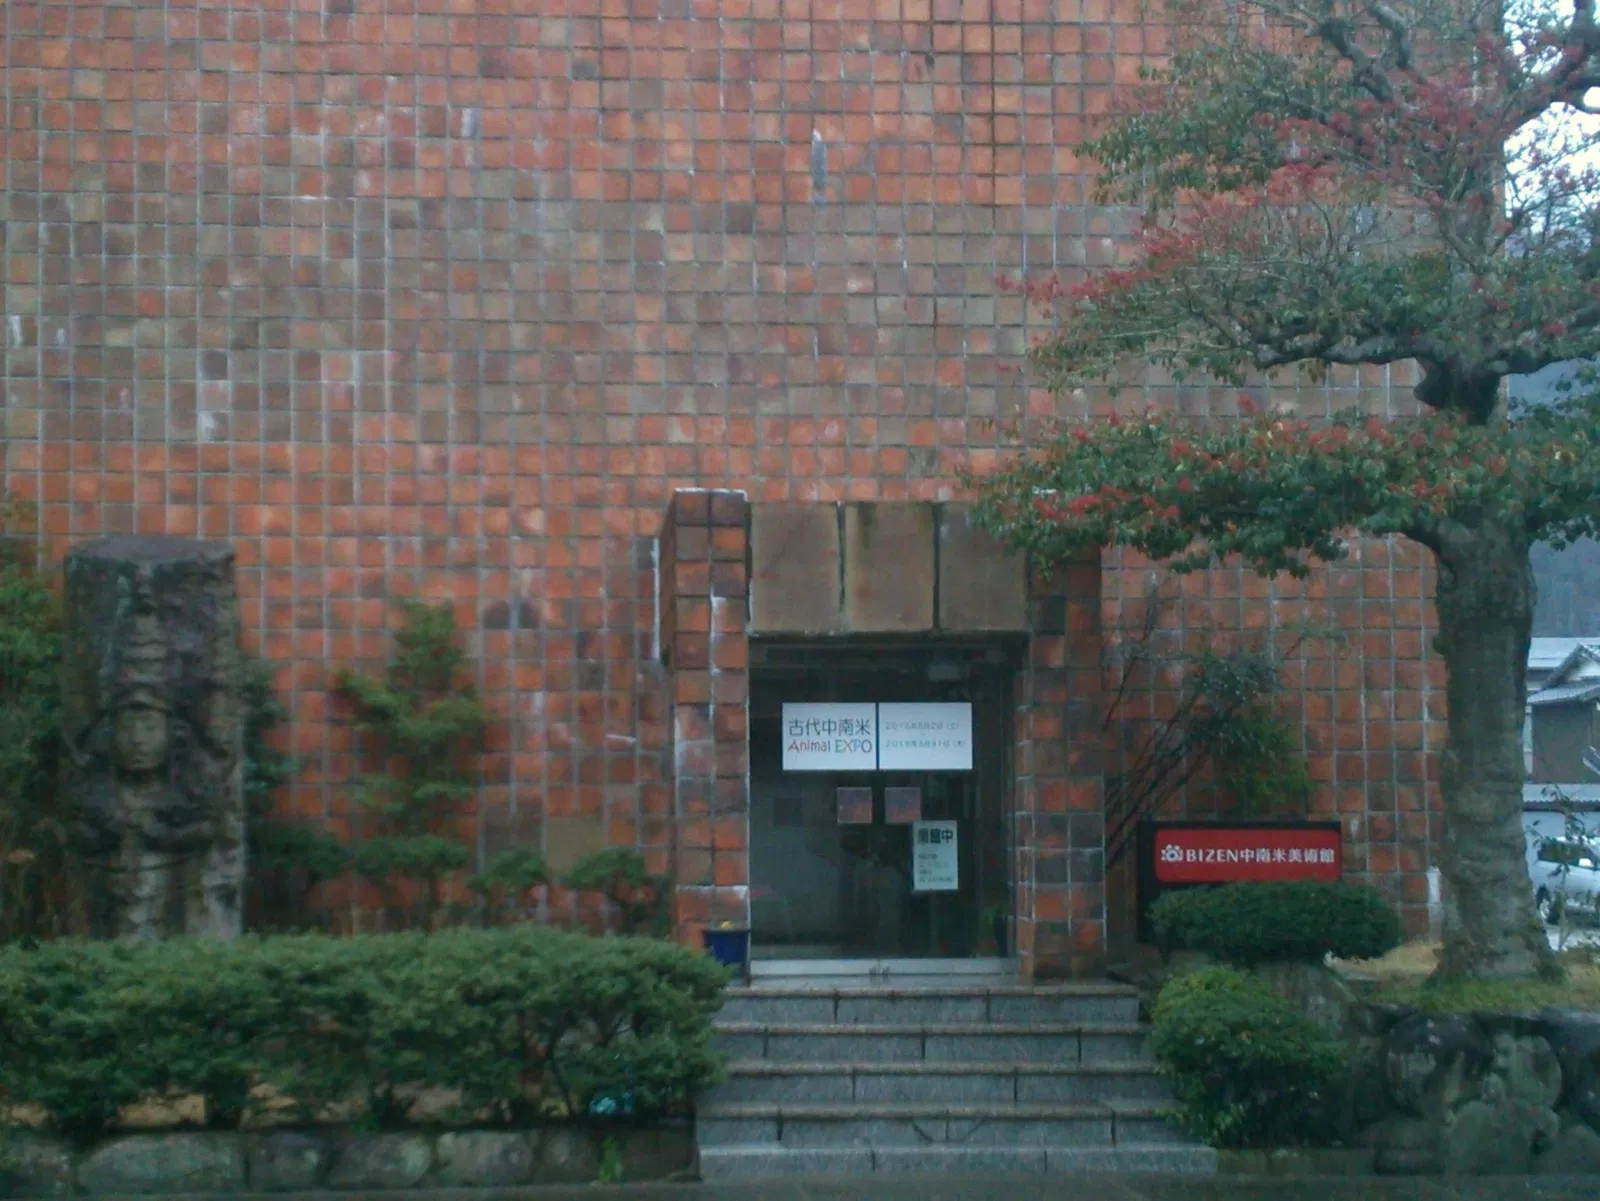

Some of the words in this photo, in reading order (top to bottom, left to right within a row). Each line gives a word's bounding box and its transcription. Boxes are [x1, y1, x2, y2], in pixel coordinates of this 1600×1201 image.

[788, 717, 871, 736] 古代中南米
[787, 739, 831, 753] Animal
[835, 739, 873, 753] EXPO
